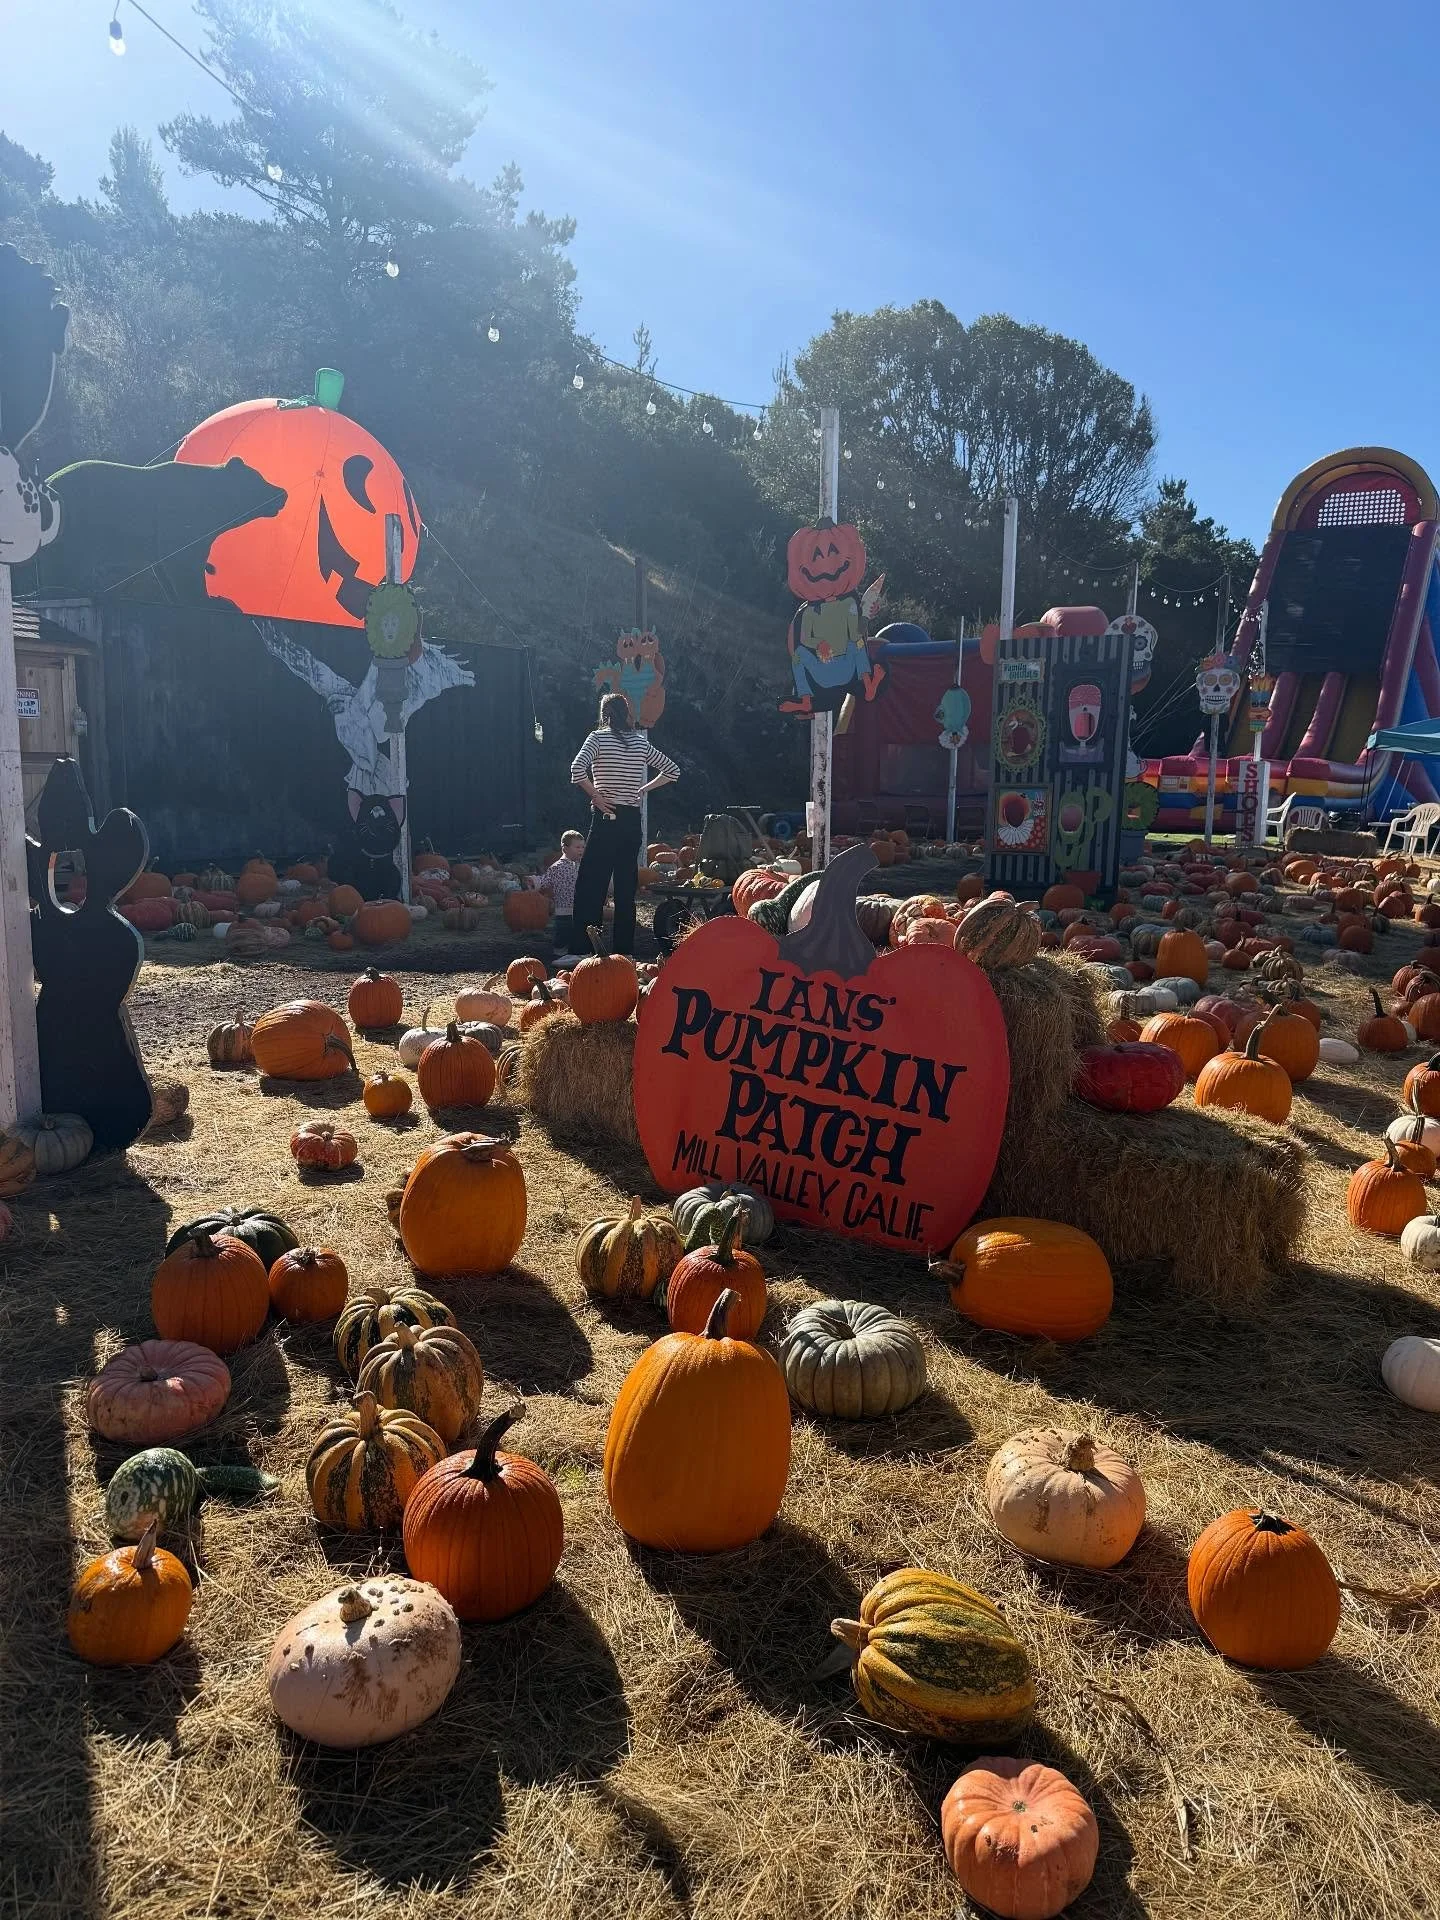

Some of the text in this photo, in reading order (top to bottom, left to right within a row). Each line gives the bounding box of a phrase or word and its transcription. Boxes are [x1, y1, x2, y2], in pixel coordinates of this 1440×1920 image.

[1241, 764, 1259, 842] SHOES
[749, 967, 897, 1032] IANS'
[661, 985, 968, 1123] PUMPKIN
[671, 1129, 722, 1181] MILL
[714, 1068, 922, 1187] PATCH
